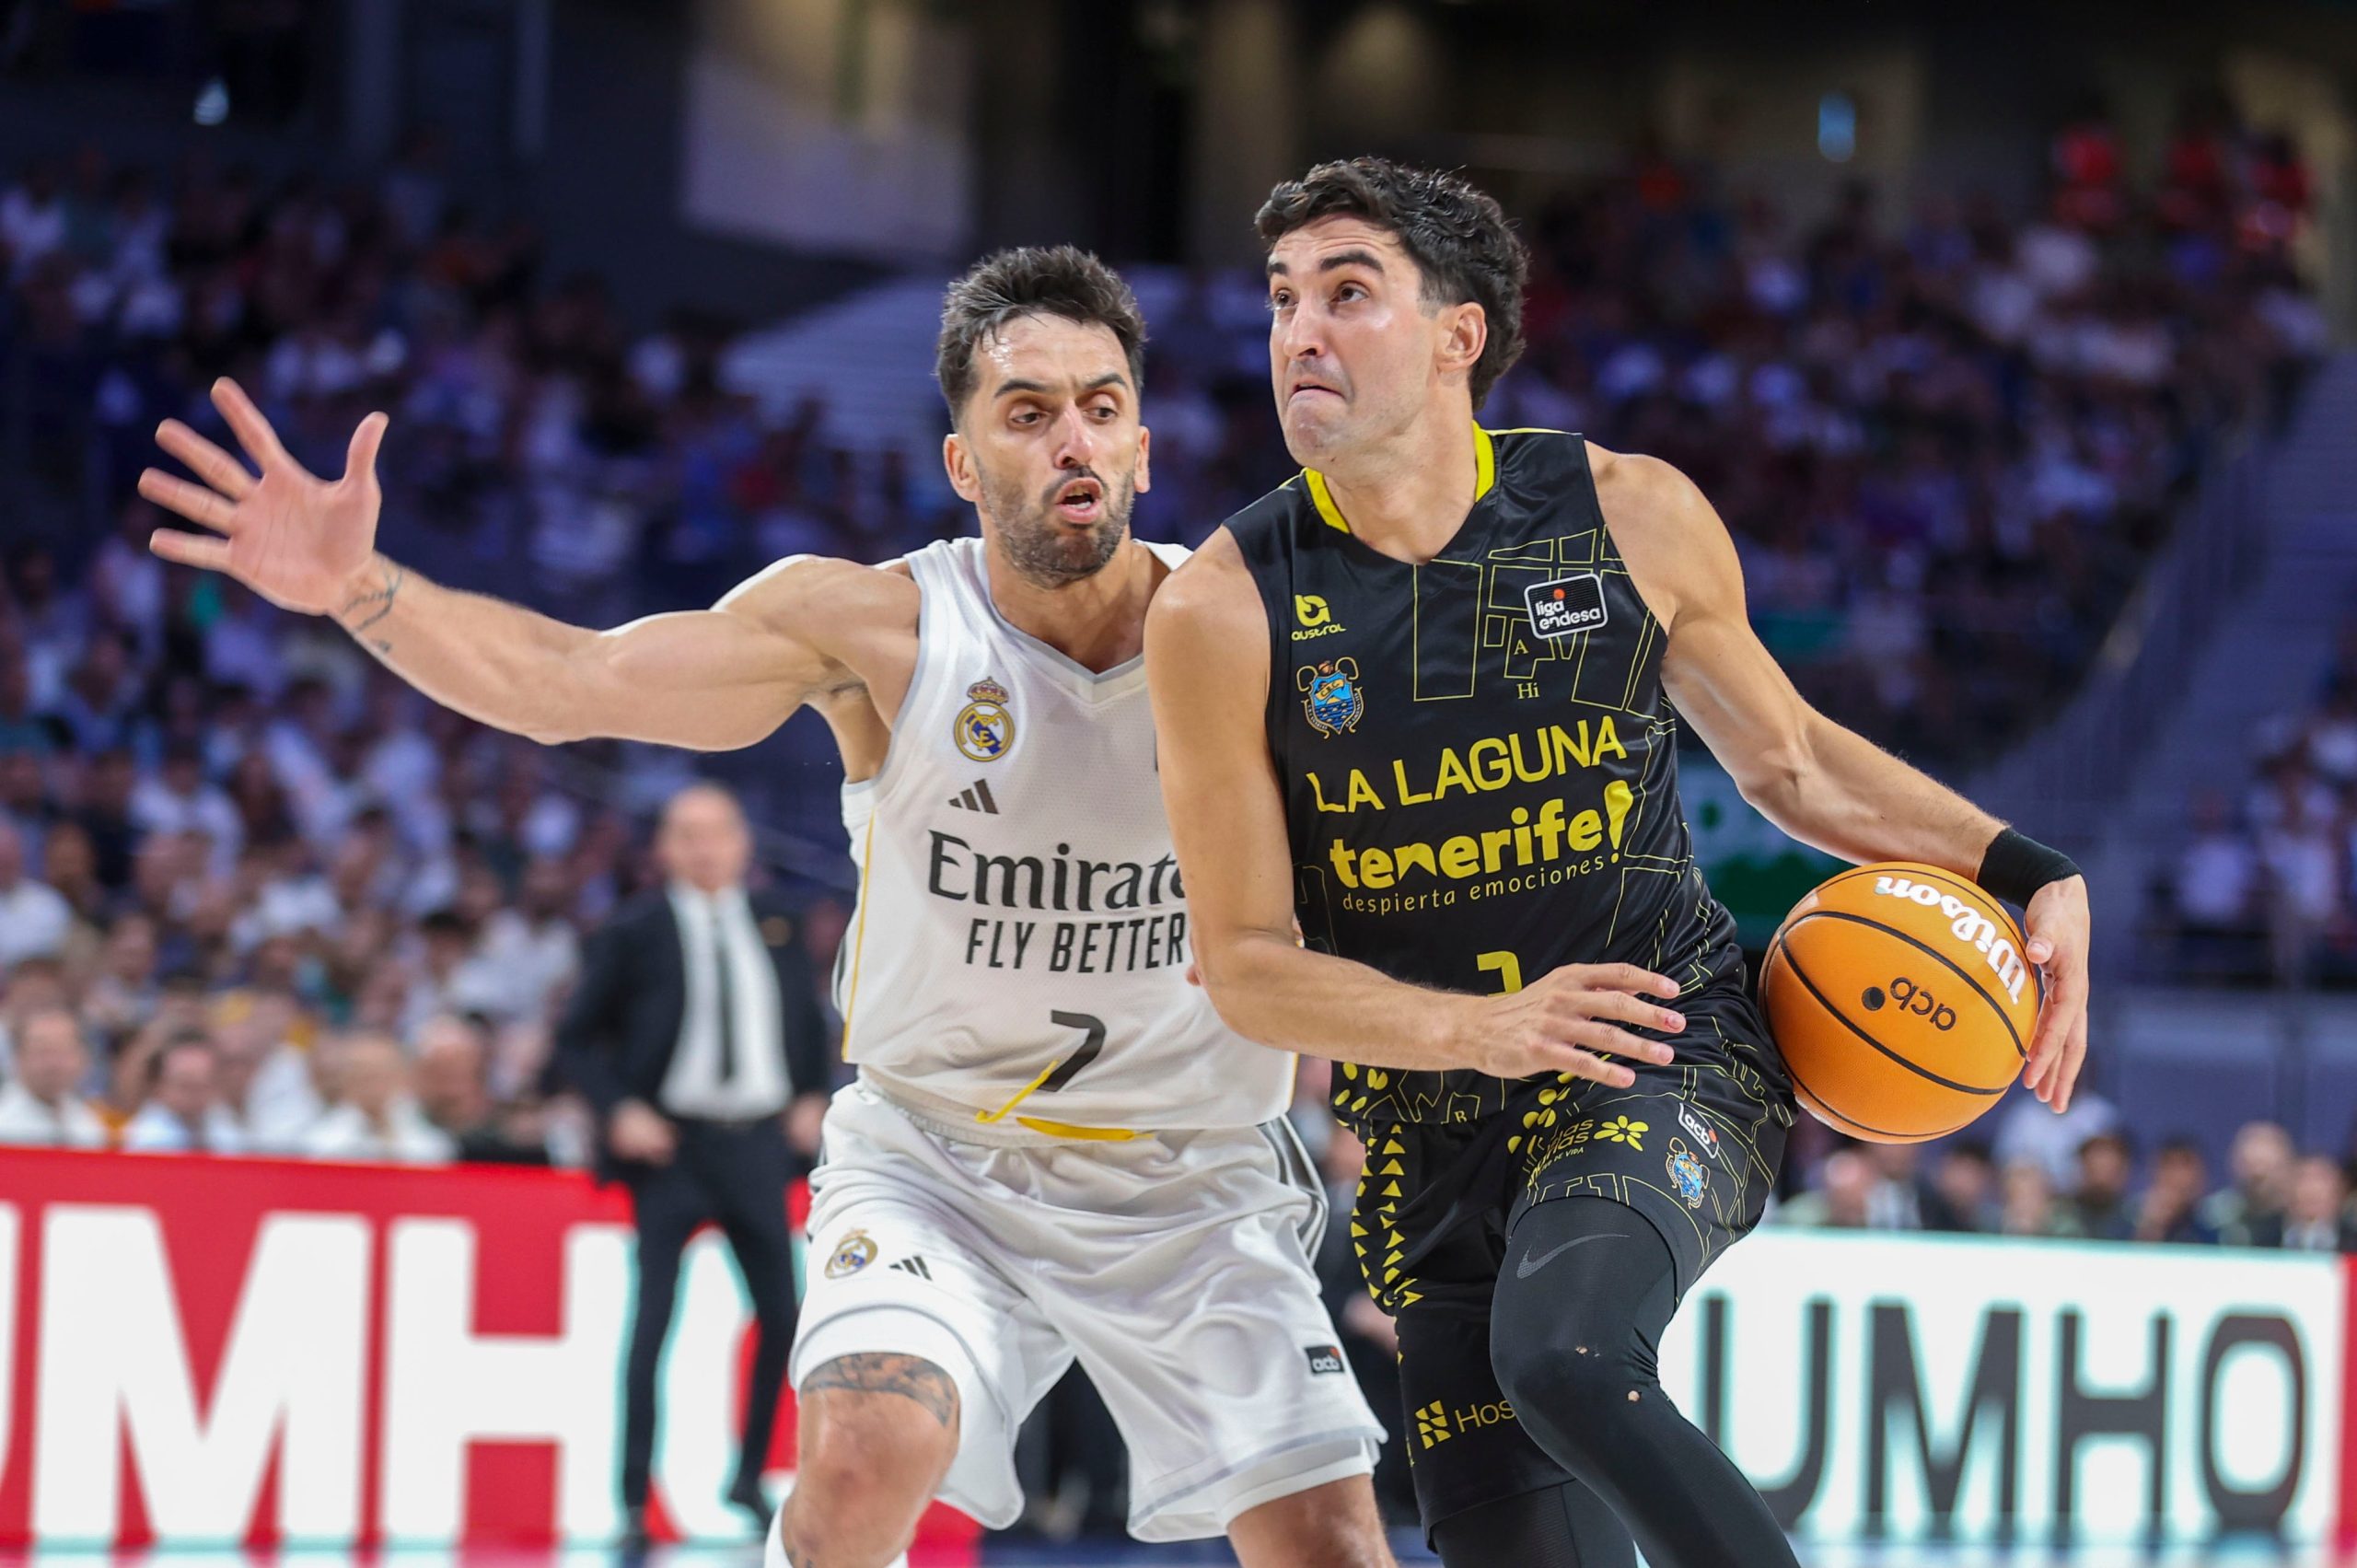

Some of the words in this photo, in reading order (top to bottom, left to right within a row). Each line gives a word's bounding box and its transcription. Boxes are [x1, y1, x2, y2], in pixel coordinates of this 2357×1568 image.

[1535, 600, 1565, 617] liga
[1538, 608, 1602, 630] endesa
[1516, 682, 1539, 699] Hi
[1306, 768, 1385, 813] LA
[1393, 715, 1628, 806] LAGUNA
[1342, 889, 1456, 916] despierta
[1470, 854, 1604, 900] emociones
[966, 919, 1035, 969] FLY
[1050, 912, 1185, 973] BETTER
[1874, 876, 2026, 1005] Wilson
[1889, 977, 1956, 1031] acb
[1037, 1009, 1107, 1093] 7
[1684, 1113, 1711, 1145] acb
[1312, 1355, 1341, 1372] acb
[1703, 1295, 2310, 1539] UMHO
